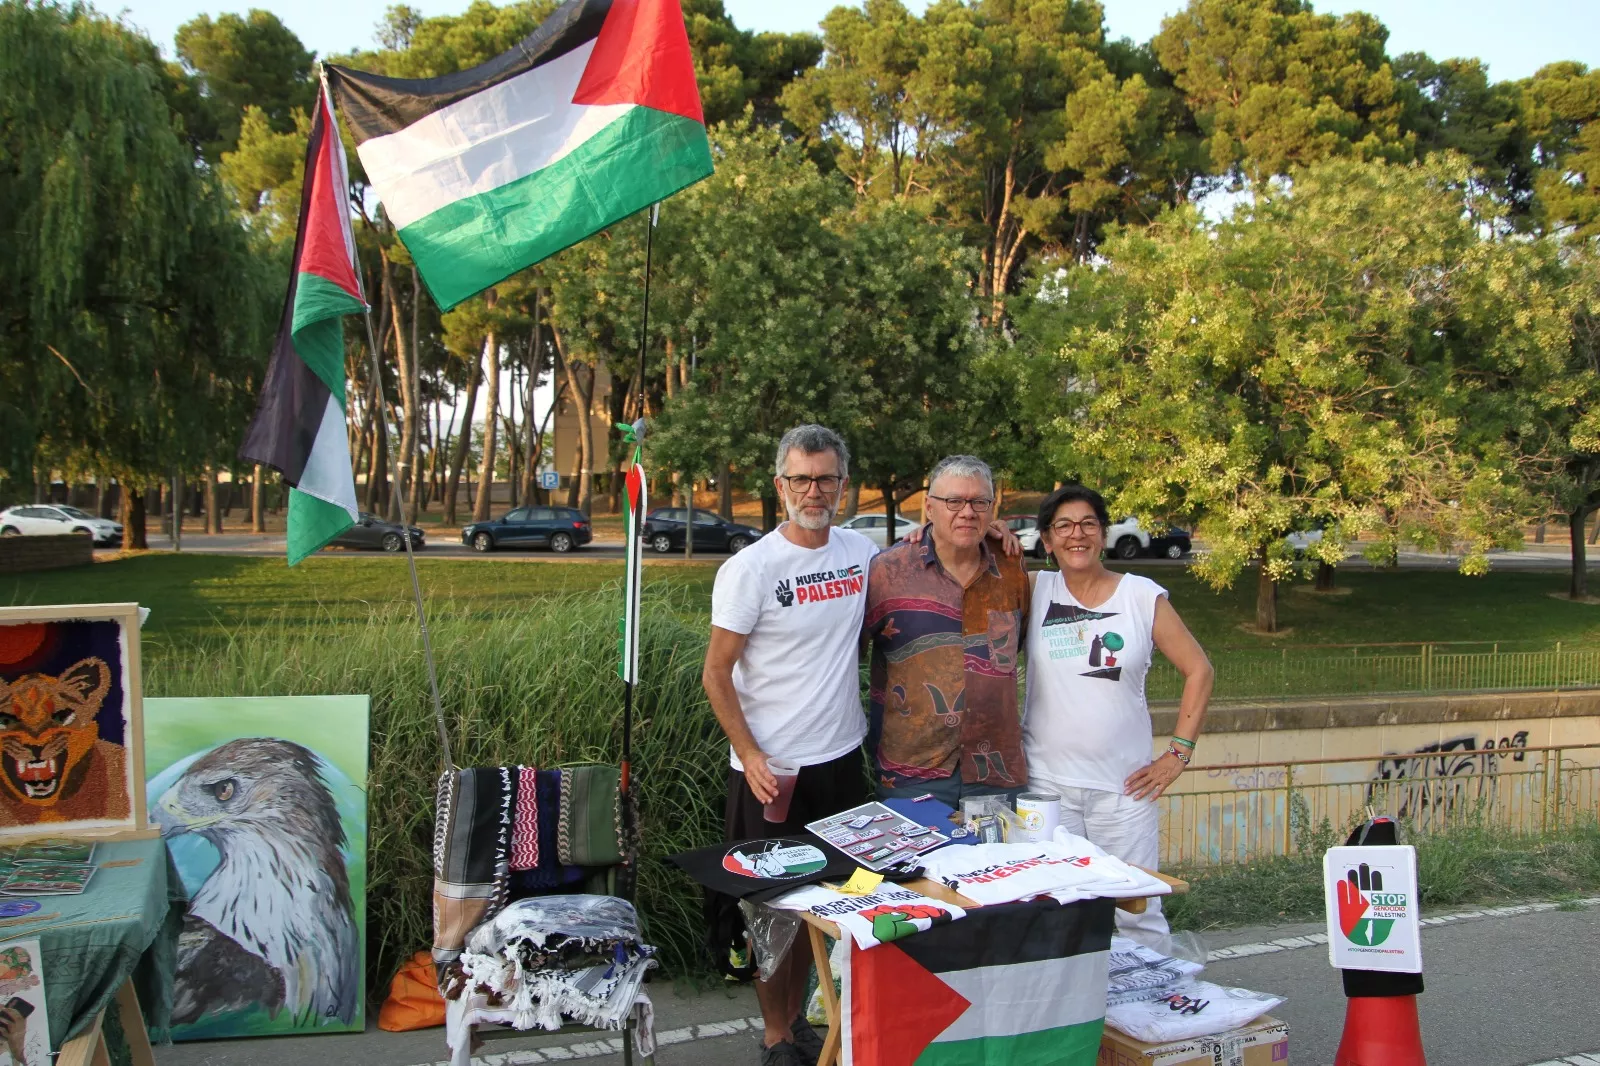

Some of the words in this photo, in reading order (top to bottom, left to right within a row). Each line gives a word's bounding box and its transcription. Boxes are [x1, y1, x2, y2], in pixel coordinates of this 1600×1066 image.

[545, 474, 556, 487] P
[795, 570, 836, 586] HUESCA
[1371, 894, 1406, 905] STOP
